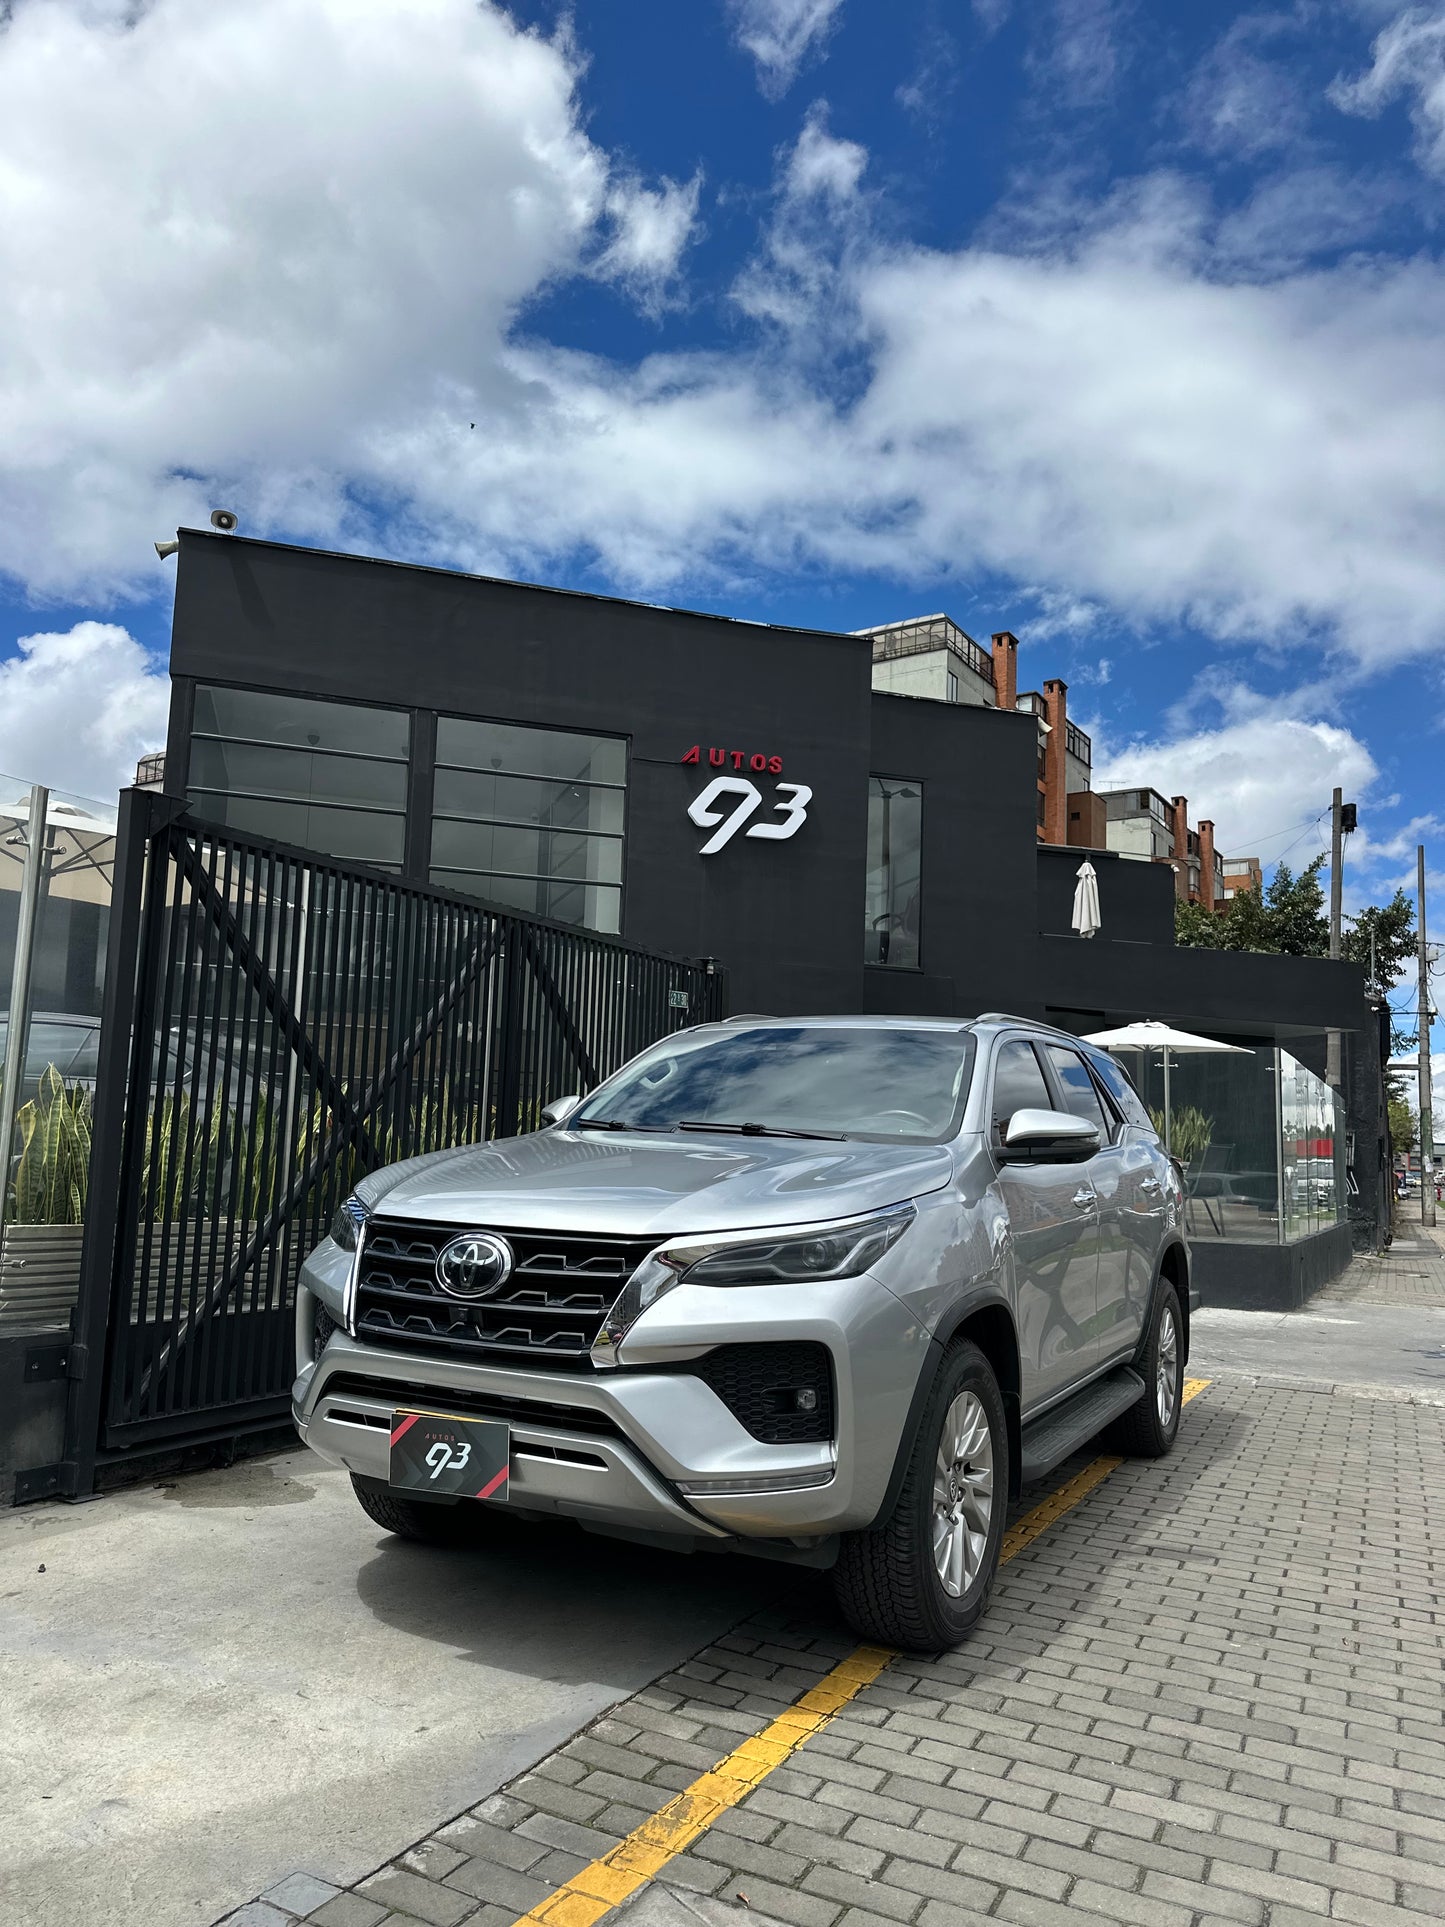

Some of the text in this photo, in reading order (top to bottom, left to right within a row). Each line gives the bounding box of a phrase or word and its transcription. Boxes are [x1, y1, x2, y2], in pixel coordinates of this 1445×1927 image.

[680, 745, 783, 774] AUTOS
[687, 776, 813, 854] 93
[425, 1432, 455, 1441] AUTOS
[425, 1442, 472, 1479] 93
